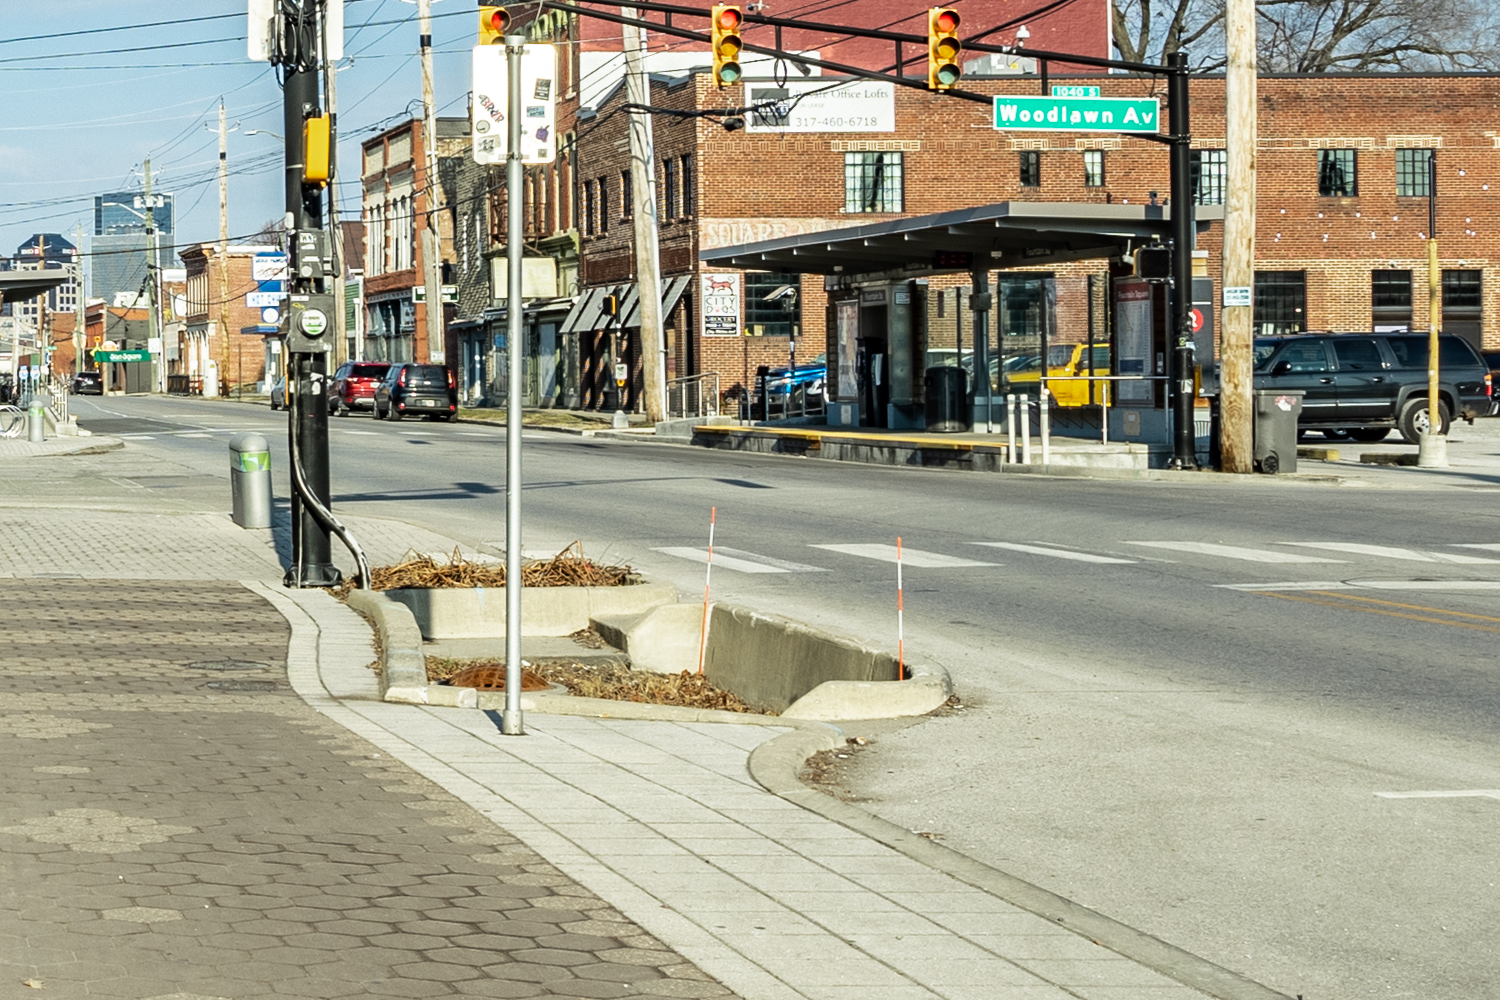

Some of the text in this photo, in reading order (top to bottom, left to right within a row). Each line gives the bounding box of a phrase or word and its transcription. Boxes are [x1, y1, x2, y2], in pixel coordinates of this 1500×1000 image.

[831, 88, 861, 100] Office
[864, 88, 889, 99] Lofts
[1056, 87, 1096, 97] 1040 S
[1000, 104, 1153, 124] Woodlawn Av
[795, 117, 878, 127] 317-460-6718
[705, 296, 736, 306] CITY
